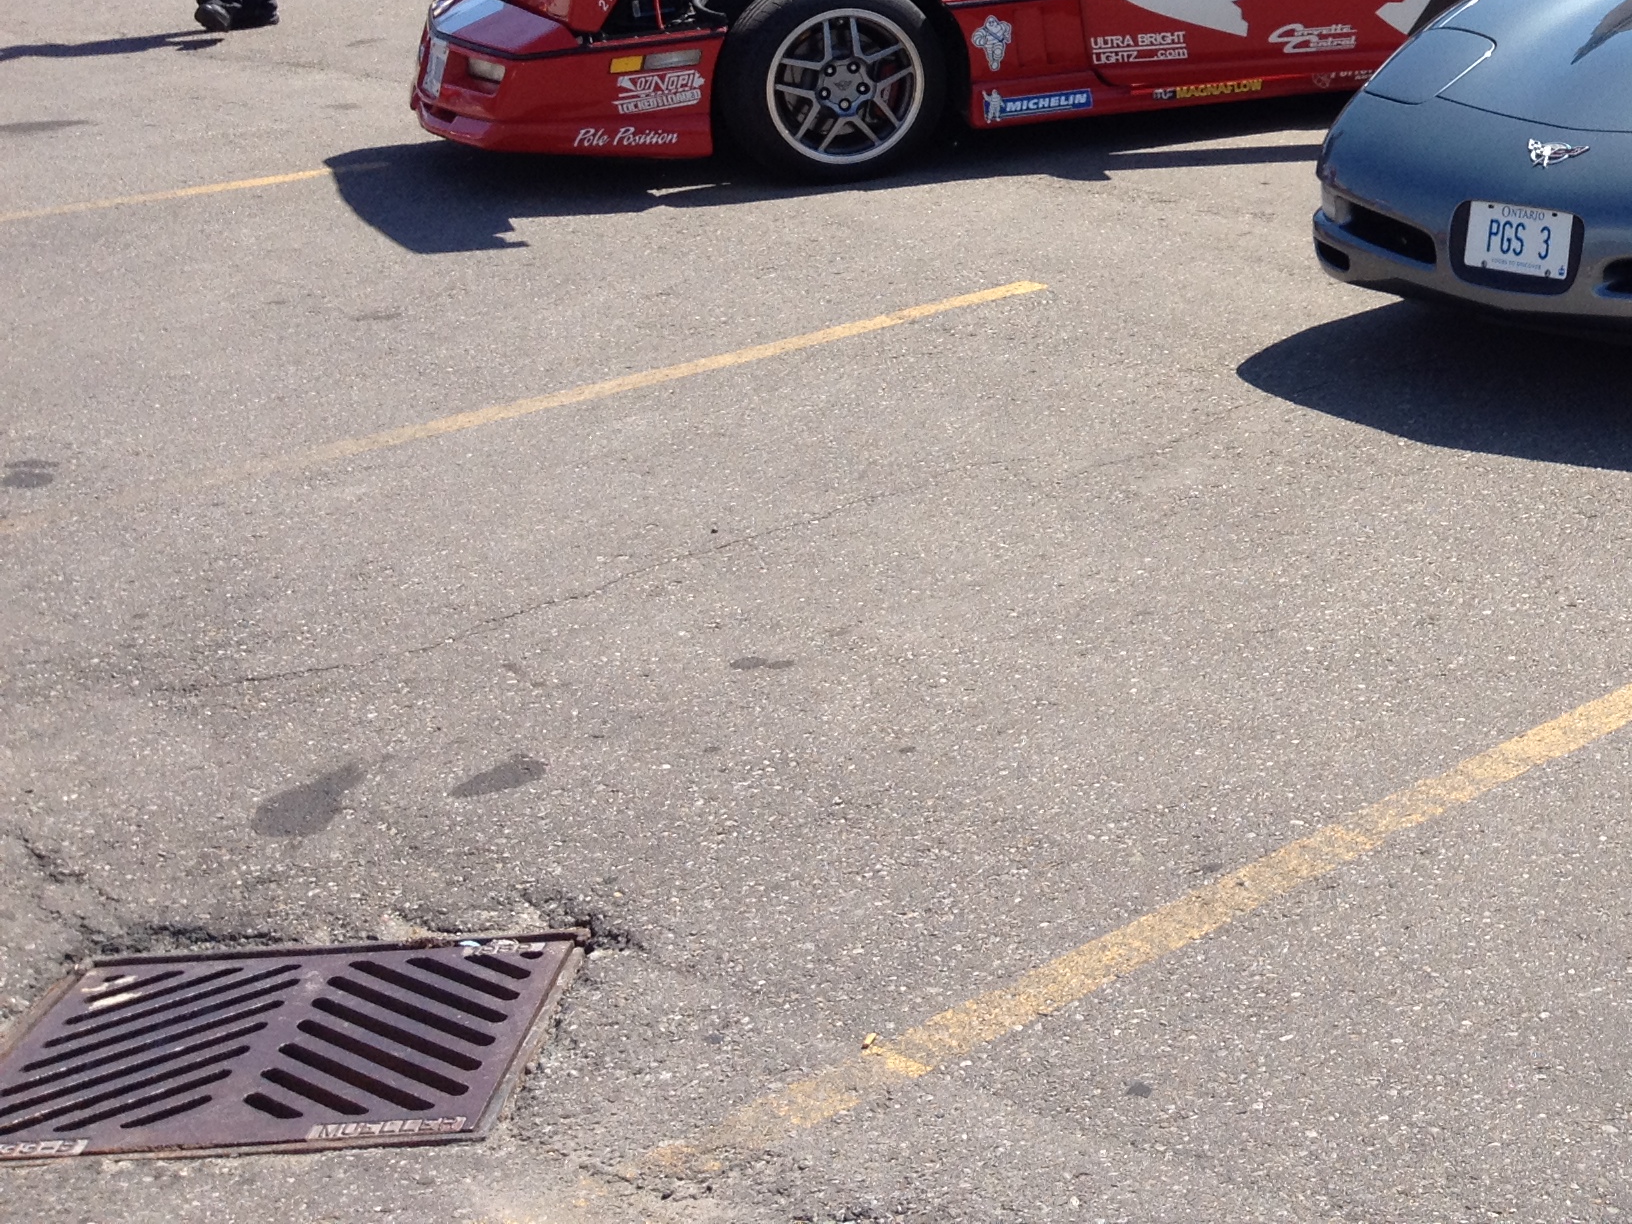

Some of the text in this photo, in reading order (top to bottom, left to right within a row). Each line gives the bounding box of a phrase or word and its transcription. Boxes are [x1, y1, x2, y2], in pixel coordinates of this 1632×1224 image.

[599, 0, 609, 11] 2
[1091, 31, 1185, 48] ULTRA BRIGHT
[1176, 79, 1262, 98] MAGNAFLOW
[1006, 93, 1087, 112] MICHELIN
[574, 127, 678, 147] Pole Position
[1502, 206, 1545, 222] ONTARIO
[1487, 219, 1551, 260] PGS 3
